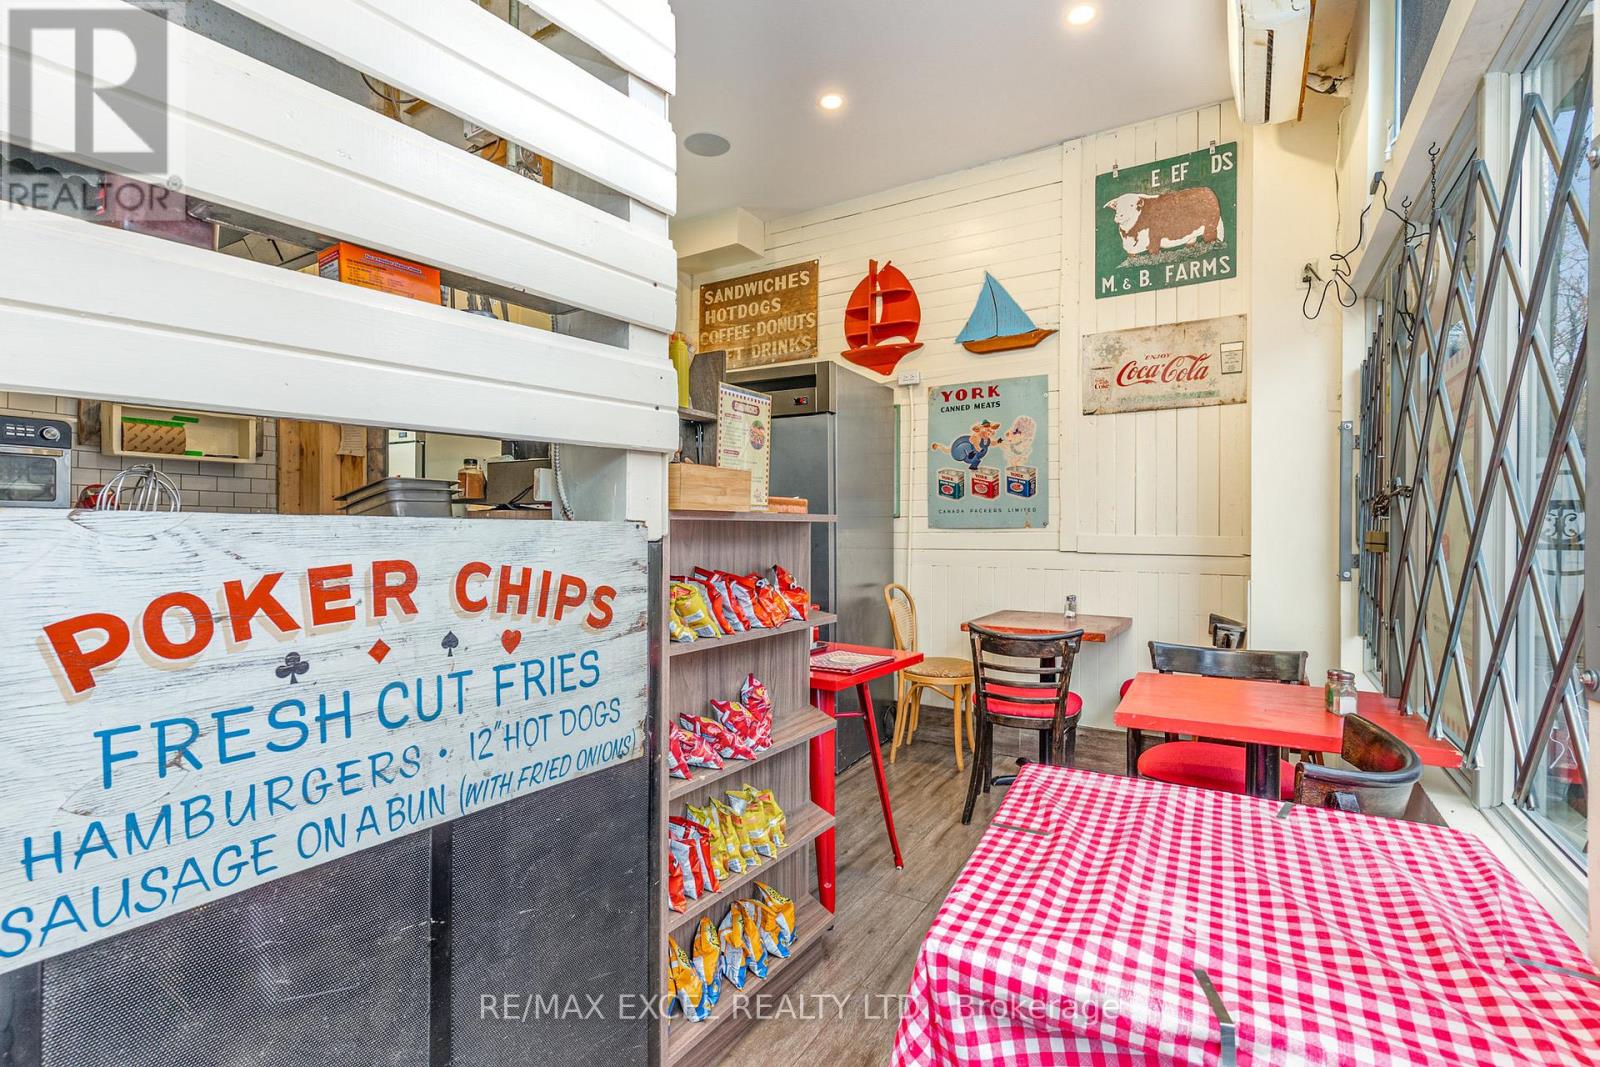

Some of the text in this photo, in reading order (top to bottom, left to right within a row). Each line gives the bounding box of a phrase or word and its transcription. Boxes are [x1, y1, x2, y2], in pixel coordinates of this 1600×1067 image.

[705, 271, 810, 305] SANDWICHES
[1102, 256, 1231, 293] M. & B. FARMS
[705, 298, 781, 325] HOTDOGS
[752, 336, 811, 358] DRINKS
[940, 401, 1001, 413] CANNED MEATS
[941, 385, 1000, 402] YORK
[40, 559, 617, 700] POKER CHIPS
[93, 650, 600, 789] FRESH CUT FRIES
[21, 745, 420, 881] HAMBURGERS
[560, 698, 620, 736] DOGS
[0, 728, 635, 957] SAUSAGE ON A BUN (WITH FRIED ONIONS)
